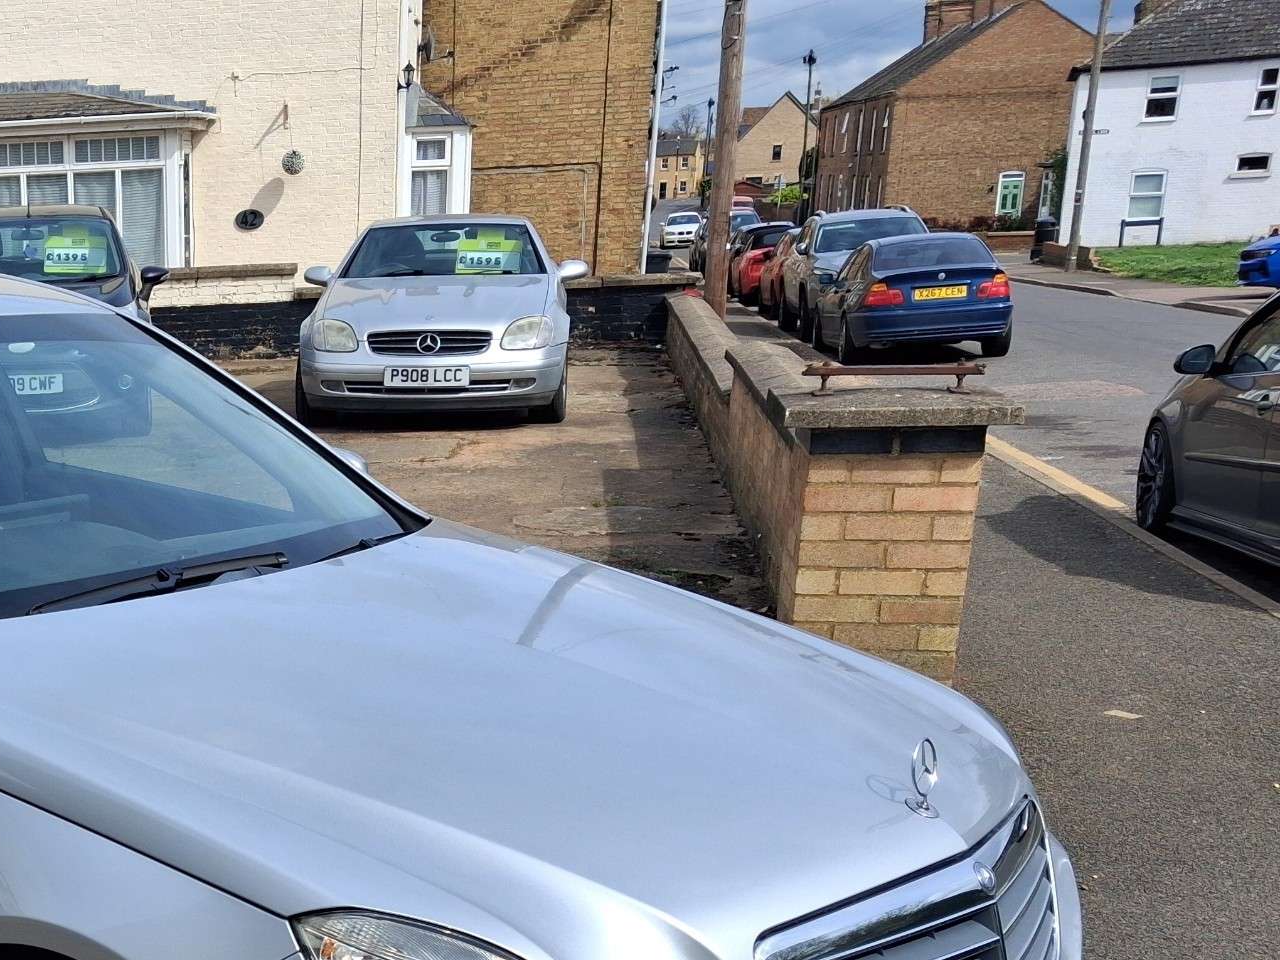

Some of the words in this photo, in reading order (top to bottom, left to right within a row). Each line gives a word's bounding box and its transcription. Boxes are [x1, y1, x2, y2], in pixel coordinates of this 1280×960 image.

[239, 211, 258, 226] 42
[46, 252, 88, 262] £1395
[29, 375, 57, 391] CWF
[390, 368, 429, 383] P908
[433, 368, 463, 383] LCC
